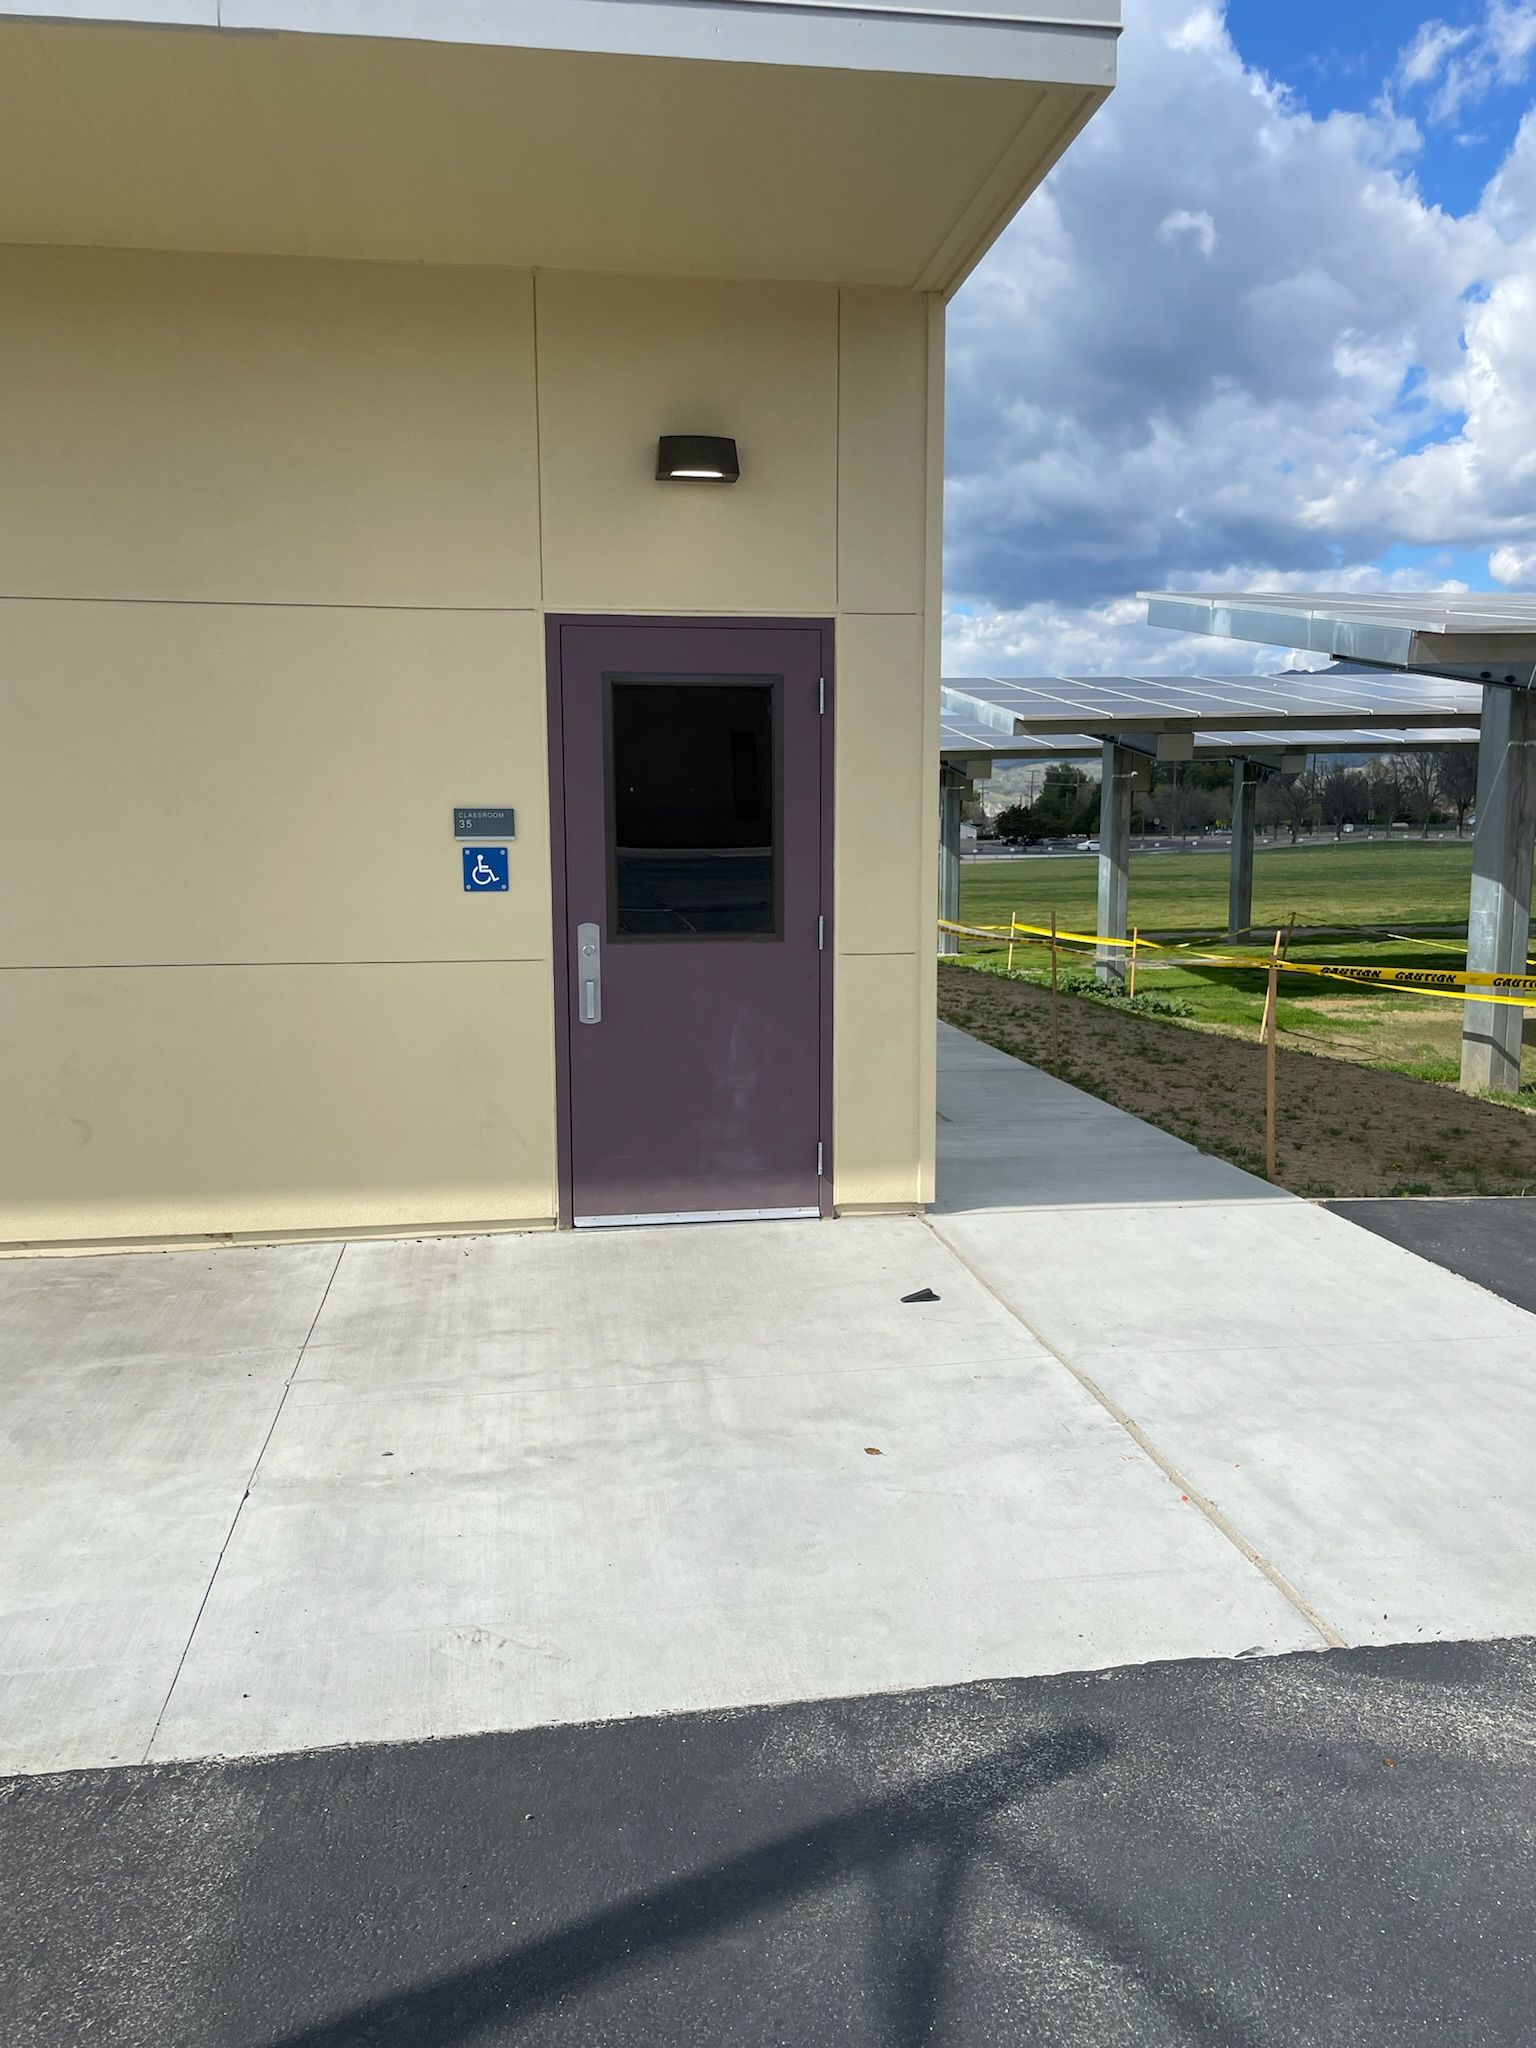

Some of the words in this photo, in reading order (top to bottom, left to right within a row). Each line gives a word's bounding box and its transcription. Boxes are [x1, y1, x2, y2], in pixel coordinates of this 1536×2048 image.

[458, 819, 472, 829] 35
[1320, 966, 1382, 978] CAUTION
[1395, 971, 1457, 983] CAUTION
[1493, 977, 1536, 989] CAUTI
